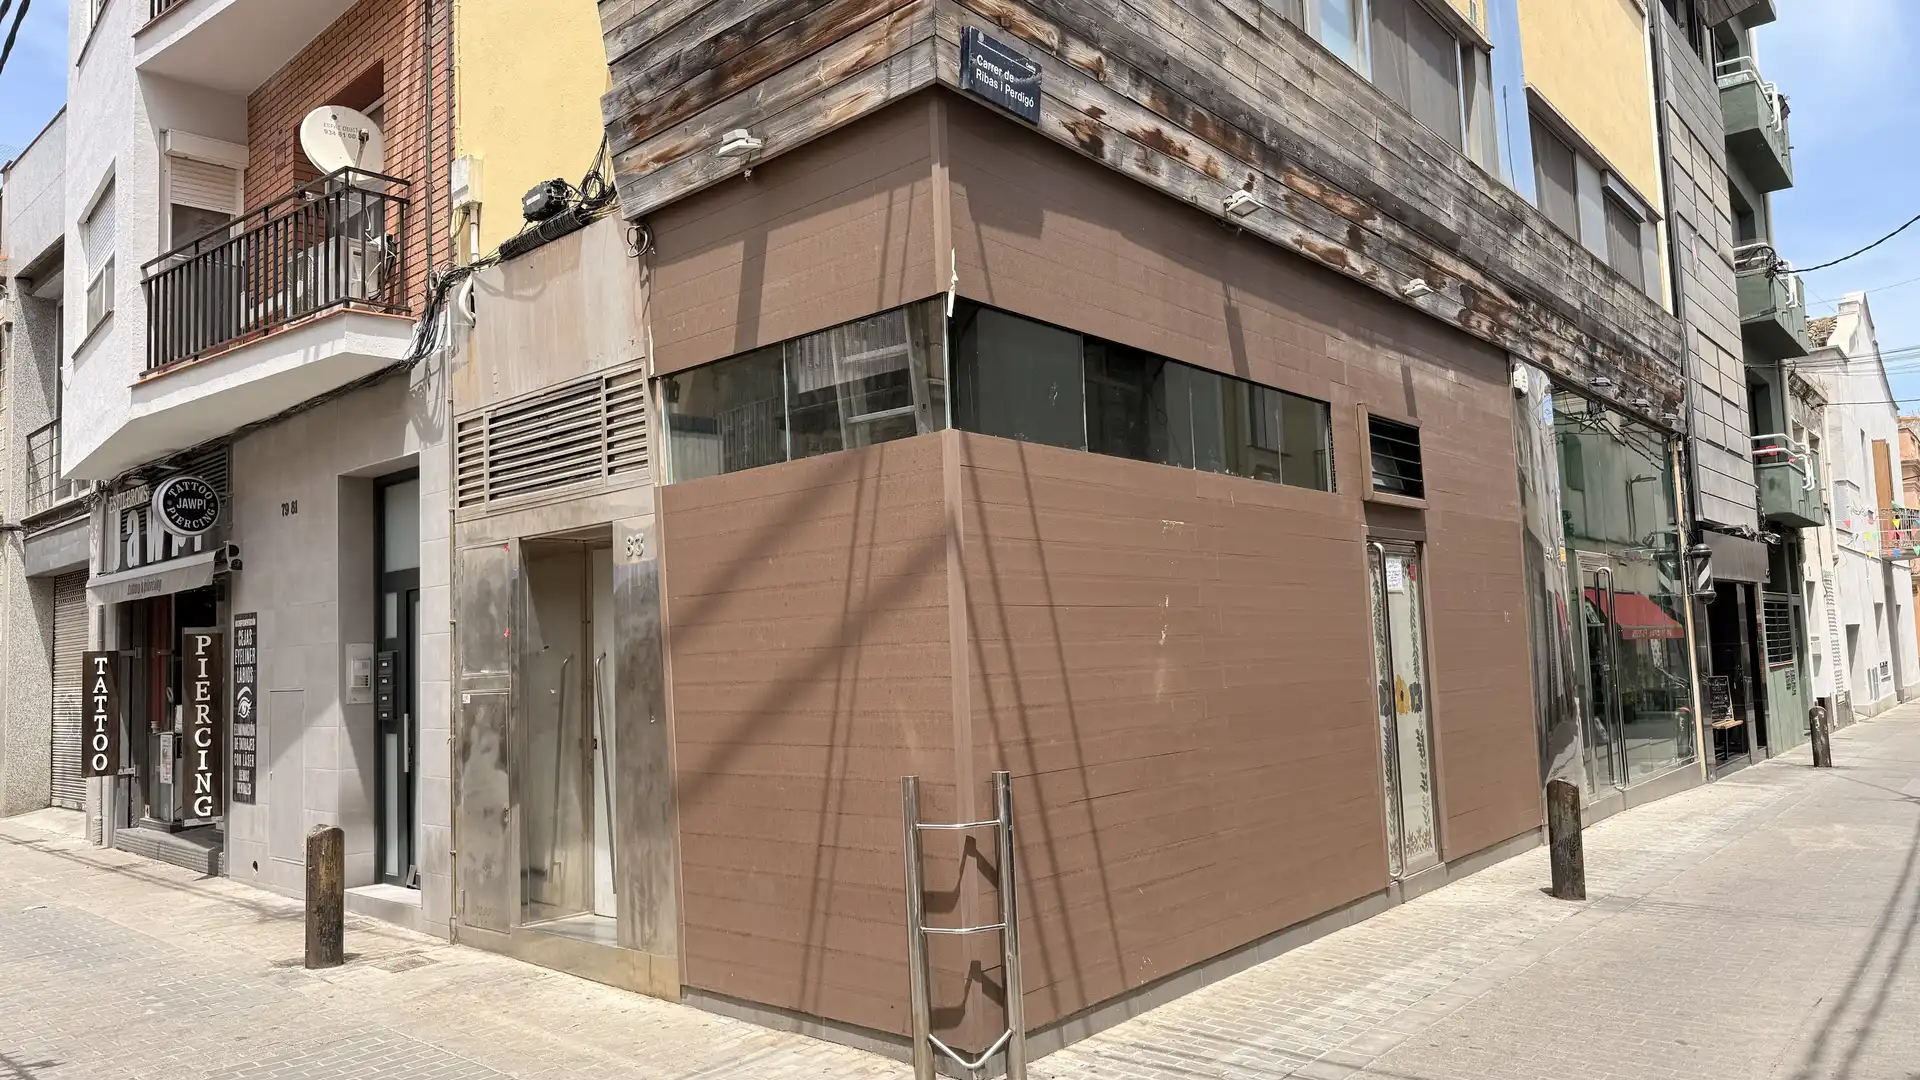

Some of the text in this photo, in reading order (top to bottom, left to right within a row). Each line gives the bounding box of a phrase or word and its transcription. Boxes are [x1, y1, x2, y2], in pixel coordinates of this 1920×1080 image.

[976, 54, 1014, 83] Carrer de
[976, 68, 998, 89] Ribas
[1005, 83, 1034, 107] Perdigó
[168, 481, 213, 499] TATTOO
[176, 497, 206, 510] JAWPI
[280, 502, 290, 517] 79
[167, 507, 215, 529] PIERCING
[238, 628, 253, 646] CEJAS
[235, 647, 256, 665] EYELINER
[92, 657, 108, 771] TATTOO
[194, 635, 213, 817] PIERCING
